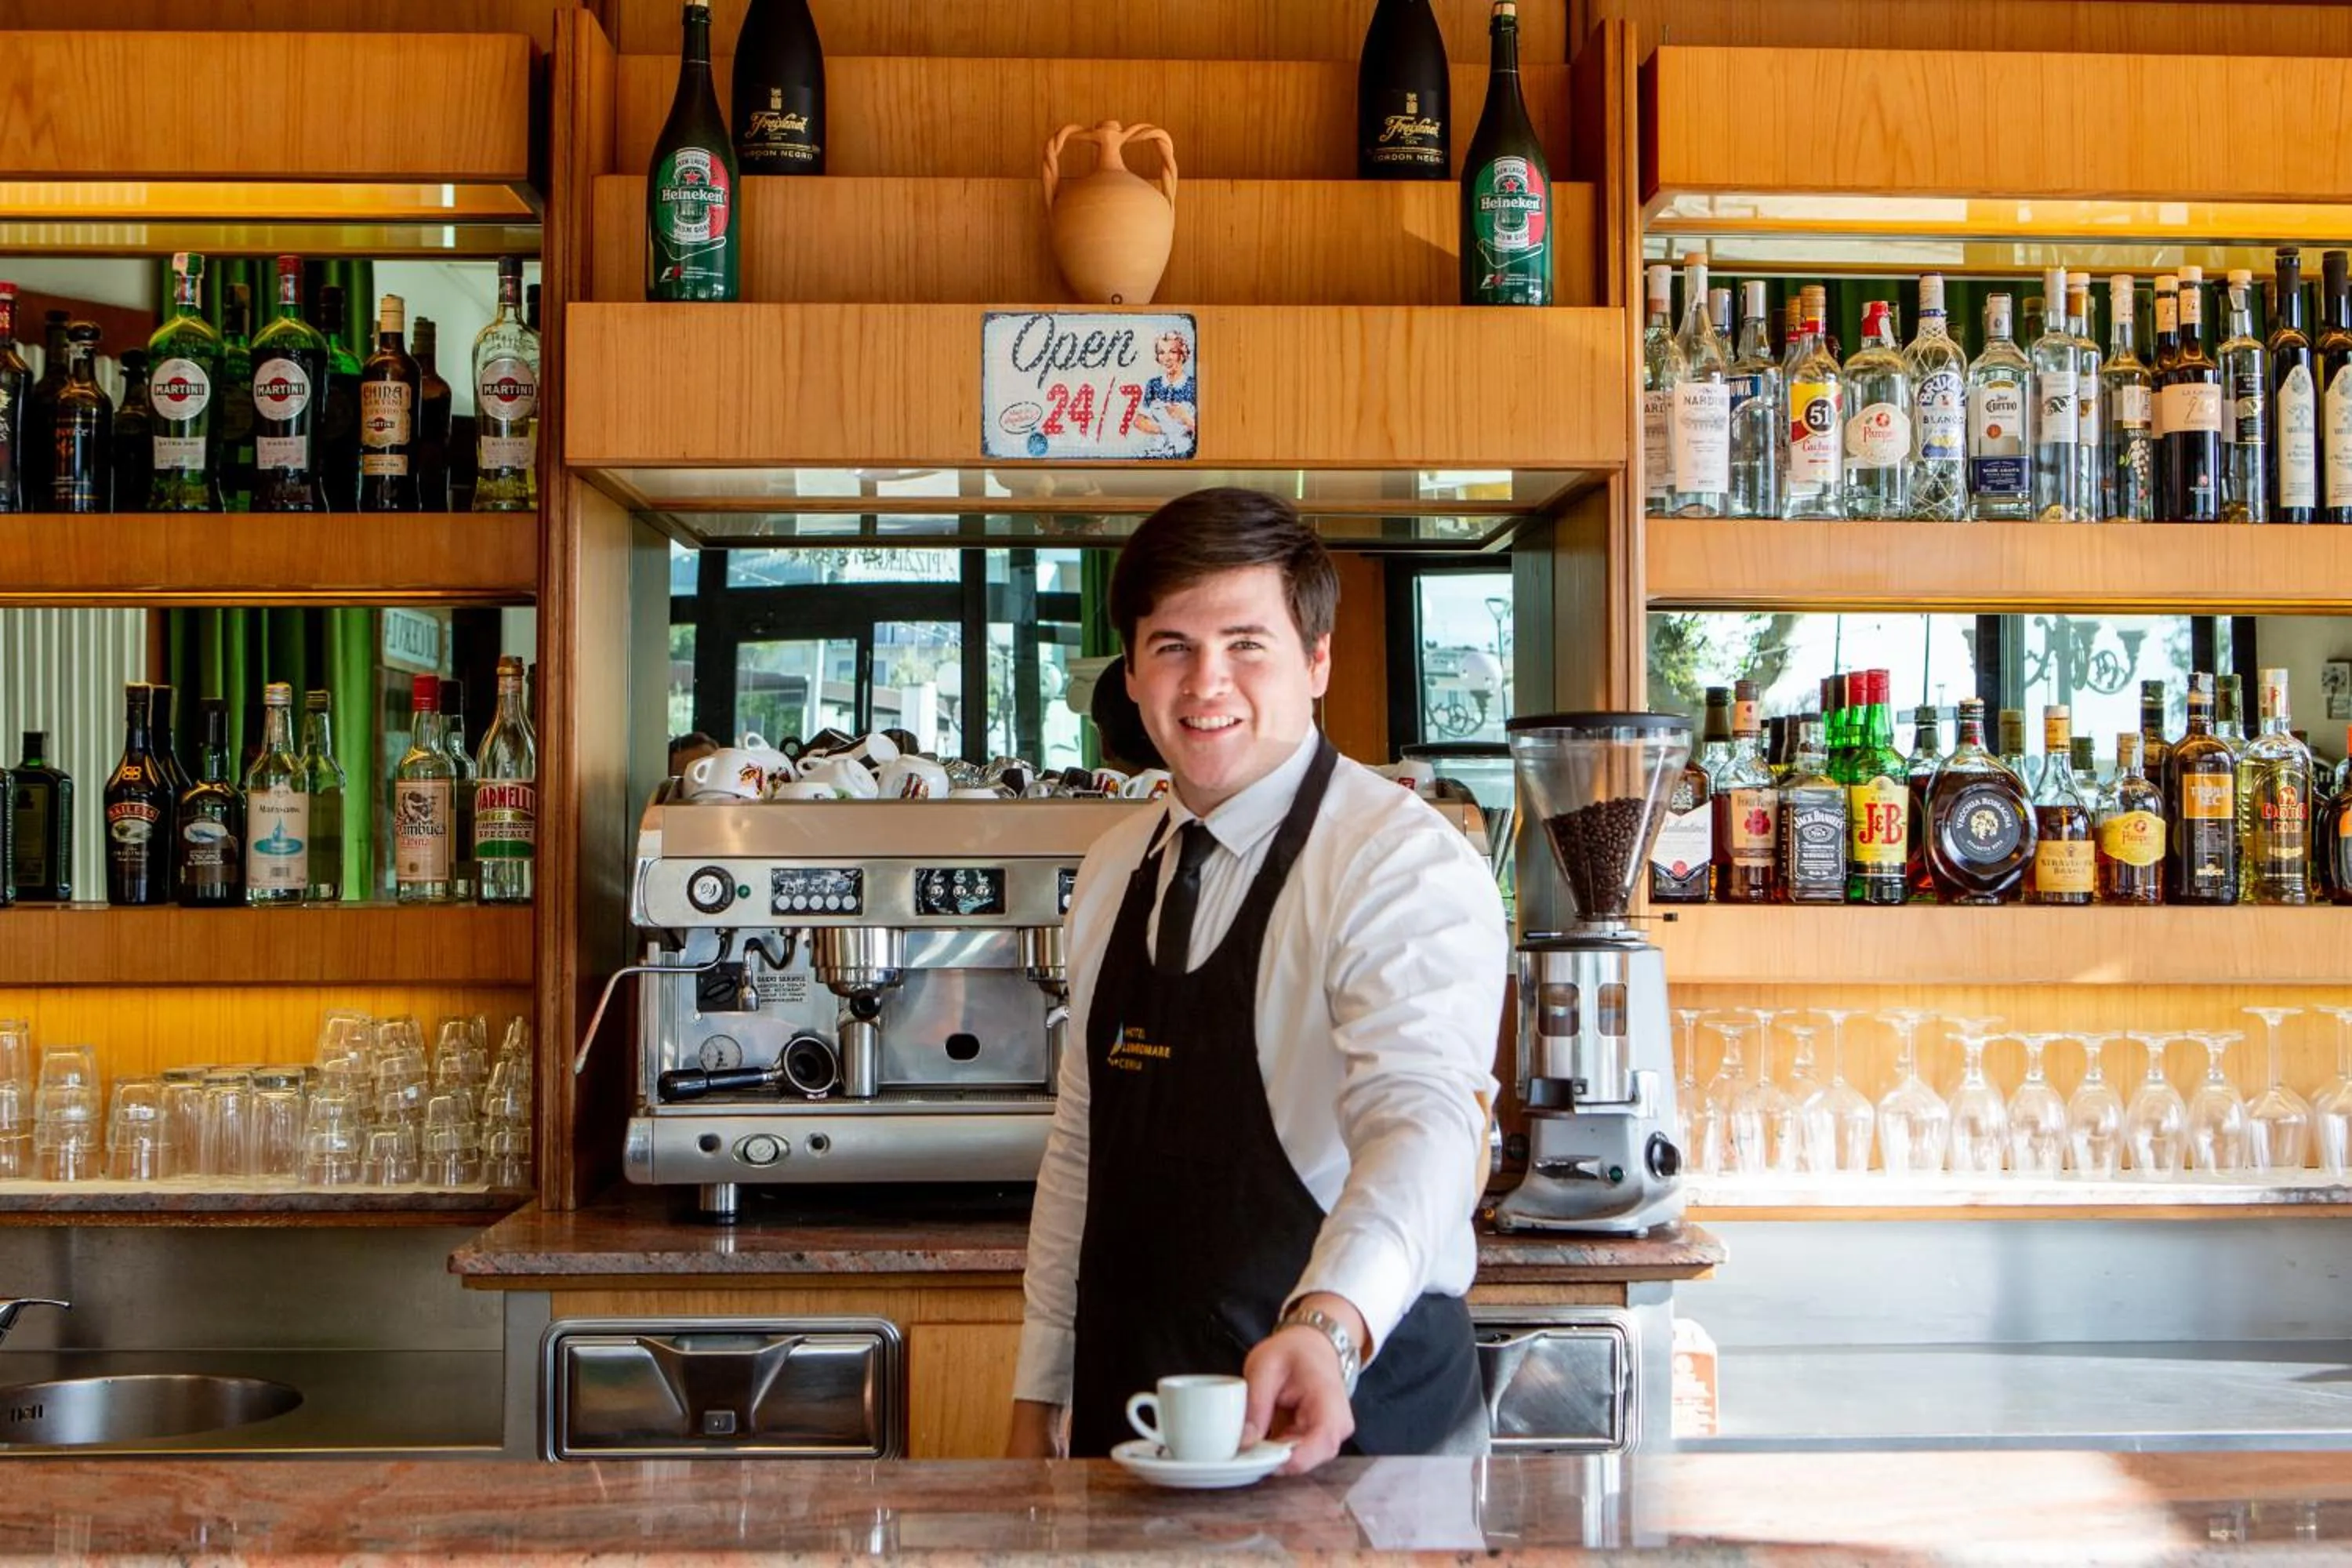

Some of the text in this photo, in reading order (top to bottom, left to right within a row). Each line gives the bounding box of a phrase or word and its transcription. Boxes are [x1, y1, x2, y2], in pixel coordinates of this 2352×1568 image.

[661, 188, 724, 204] Heineken
[1480, 197, 1541, 209] Heineken
[1012, 314, 1138, 390] Open
[155, 383, 205, 395] MARTINI
[257, 383, 304, 396] MARTINI
[483, 384, 533, 396] MARTINI
[1041, 376, 1143, 444] 24/7
[1809, 405, 1830, 426] 51
[1858, 802, 1903, 844] J&B
